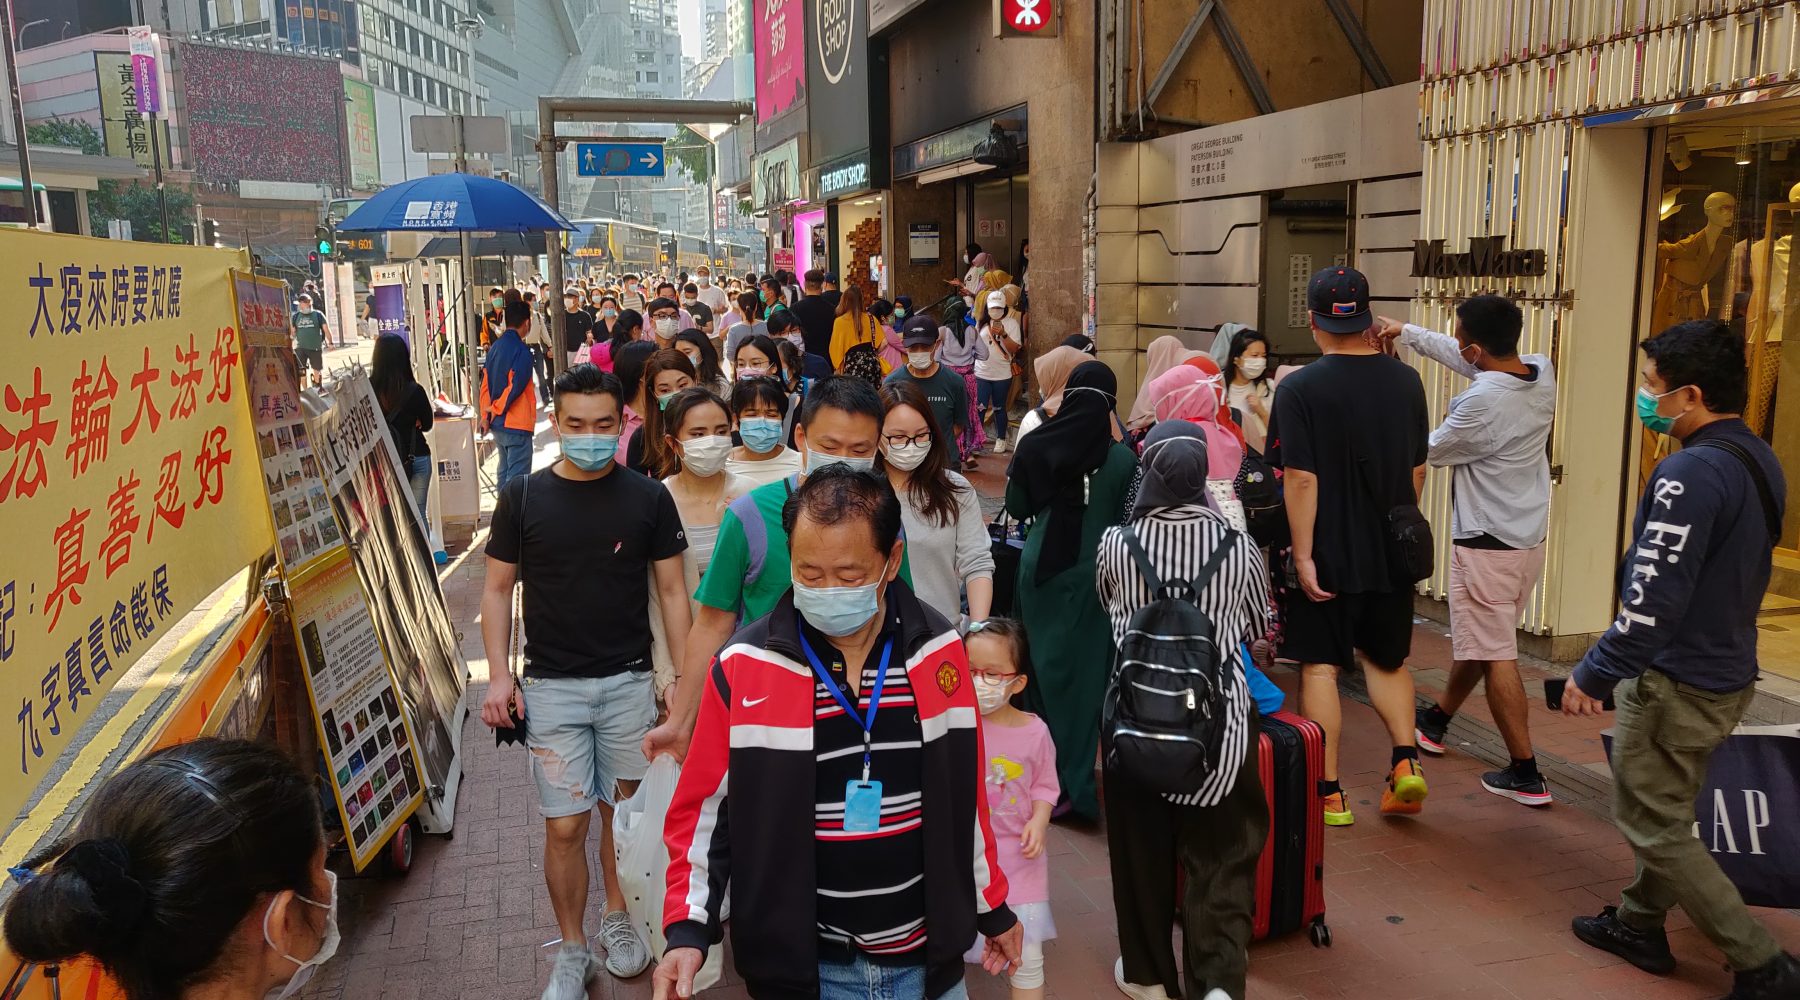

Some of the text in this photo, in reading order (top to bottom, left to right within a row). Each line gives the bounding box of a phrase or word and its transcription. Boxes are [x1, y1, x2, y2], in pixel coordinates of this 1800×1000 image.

[771, 12, 786, 57] 莎莎
[826, 19, 846, 57] SHOP
[118, 63, 148, 154] 黃金廣場
[1222, 133, 1243, 145] BUILDING
[821, 173, 832, 193] THE
[832, 168, 848, 190] BODY
[358, 239, 373, 250] 601
[28, 262, 182, 339] 大疫來時要知曉
[0, 326, 239, 500] 法輪大法好
[258, 391, 299, 421] 真善忍
[43, 425, 233, 634] 真善忍好
[1620, 477, 1692, 634] & Fitch
[17, 563, 174, 775] 九字真言命能保
[1691, 788, 1770, 855] AP
